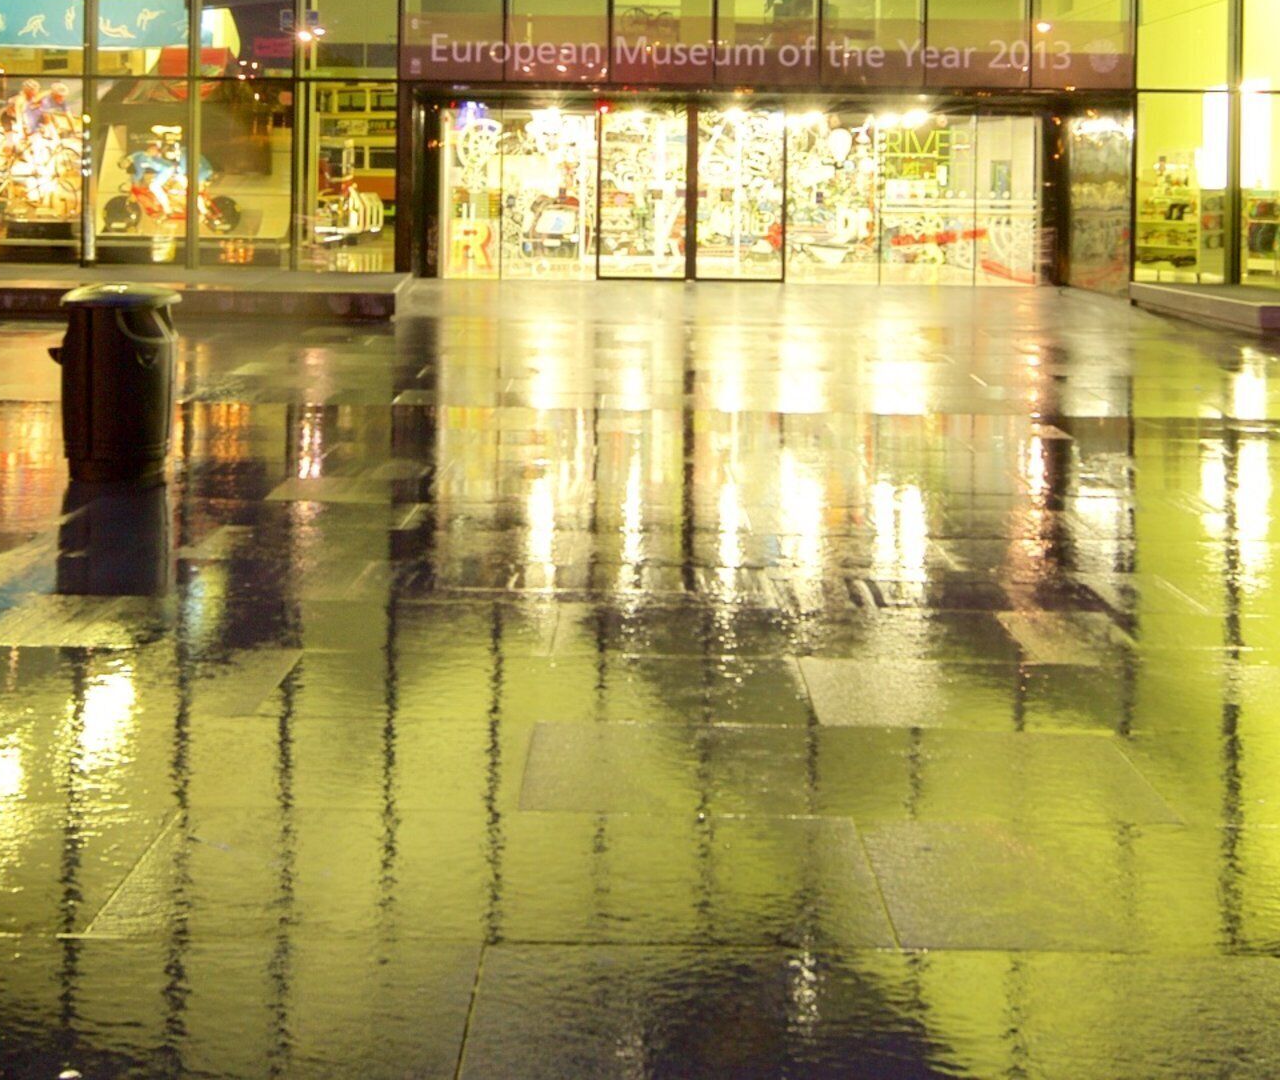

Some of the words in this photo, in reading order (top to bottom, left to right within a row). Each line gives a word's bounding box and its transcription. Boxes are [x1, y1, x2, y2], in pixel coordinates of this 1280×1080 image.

[430, 33, 601, 70] European
[615, 36, 765, 66] Museum
[778, 36, 817, 66] of
[826, 37, 885, 67] the
[898, 38, 977, 69] Year
[987, 39, 1071, 70] 2013
